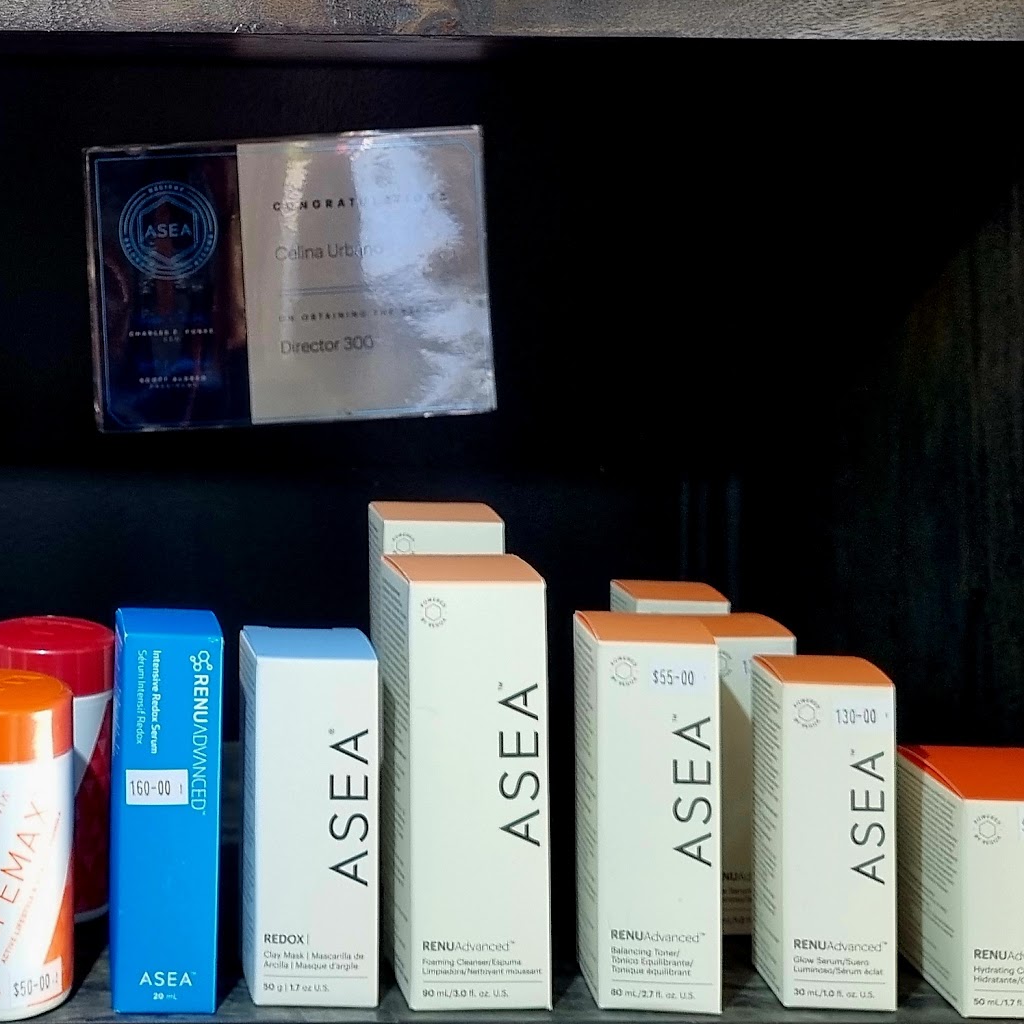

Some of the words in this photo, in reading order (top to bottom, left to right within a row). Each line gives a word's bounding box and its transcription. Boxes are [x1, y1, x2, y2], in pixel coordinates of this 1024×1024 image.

[145, 223, 193, 238] ASEA
[276, 245, 324, 261] Celina
[280, 338, 339, 355] Director
[343, 335, 374, 351] 300
[151, 650, 162, 693] Intensive
[136, 680, 146, 715] Intensif
[151, 693, 162, 723] Redox
[836, 707, 877, 724] 130-00
[136, 716, 146, 745] Redox
[150, 724, 161, 755] Serum
[190, 674, 210, 810] RENUADVANCED
[498, 682, 541, 847] ASEA
[130, 780, 171, 796] 160-00
[672, 716, 713, 867] ASEA
[328, 728, 369, 887] ASEA
[849, 751, 886, 885] ASEA
[264, 934, 304, 944] REDOX
[422, 940, 509, 952] RENUAdvanced
[611, 929, 700, 943] RENUAdvanced
[794, 939, 882, 952] RENUAdvanced
[263, 951, 281, 960] Clay
[283, 951, 304, 959] Mask
[13, 973, 50, 998] $50-00
[139, 971, 193, 987] ASEA
